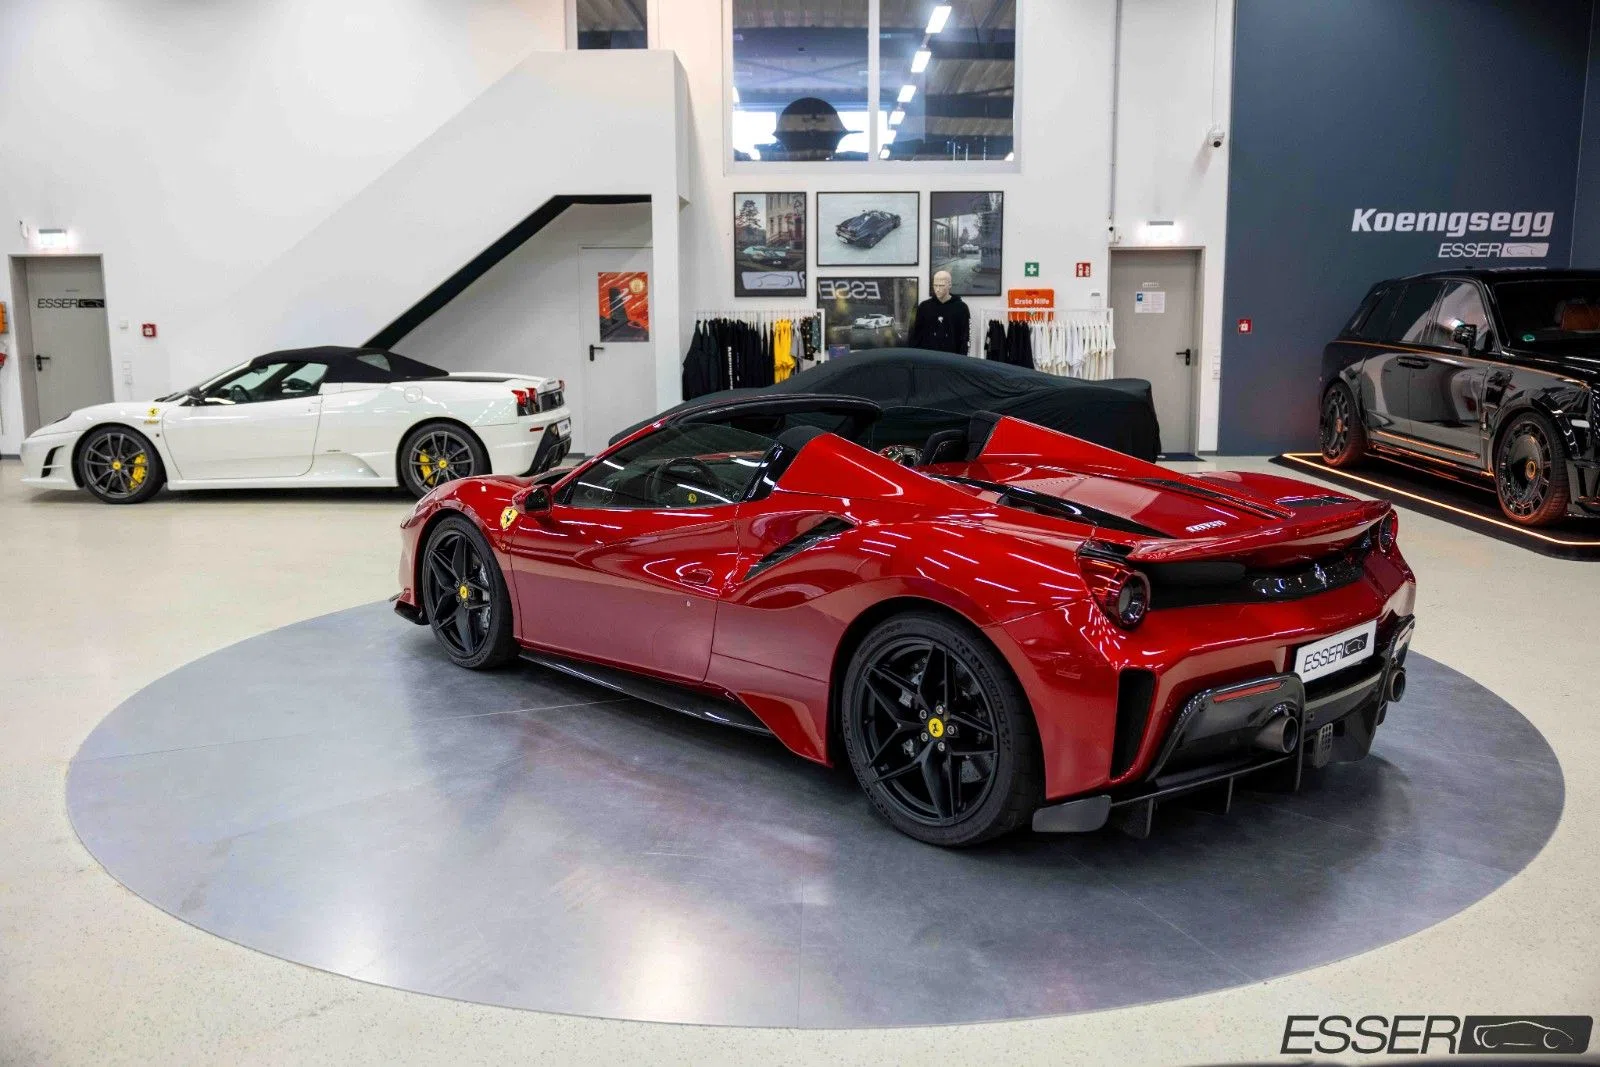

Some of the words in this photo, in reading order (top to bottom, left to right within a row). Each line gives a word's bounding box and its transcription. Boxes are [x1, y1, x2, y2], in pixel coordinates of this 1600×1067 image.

[1351, 208, 1554, 237] Koenigsegg
[1438, 243, 1502, 258] ESSER
[37, 298, 78, 309] ESSER
[1303, 643, 1344, 673] ESSER
